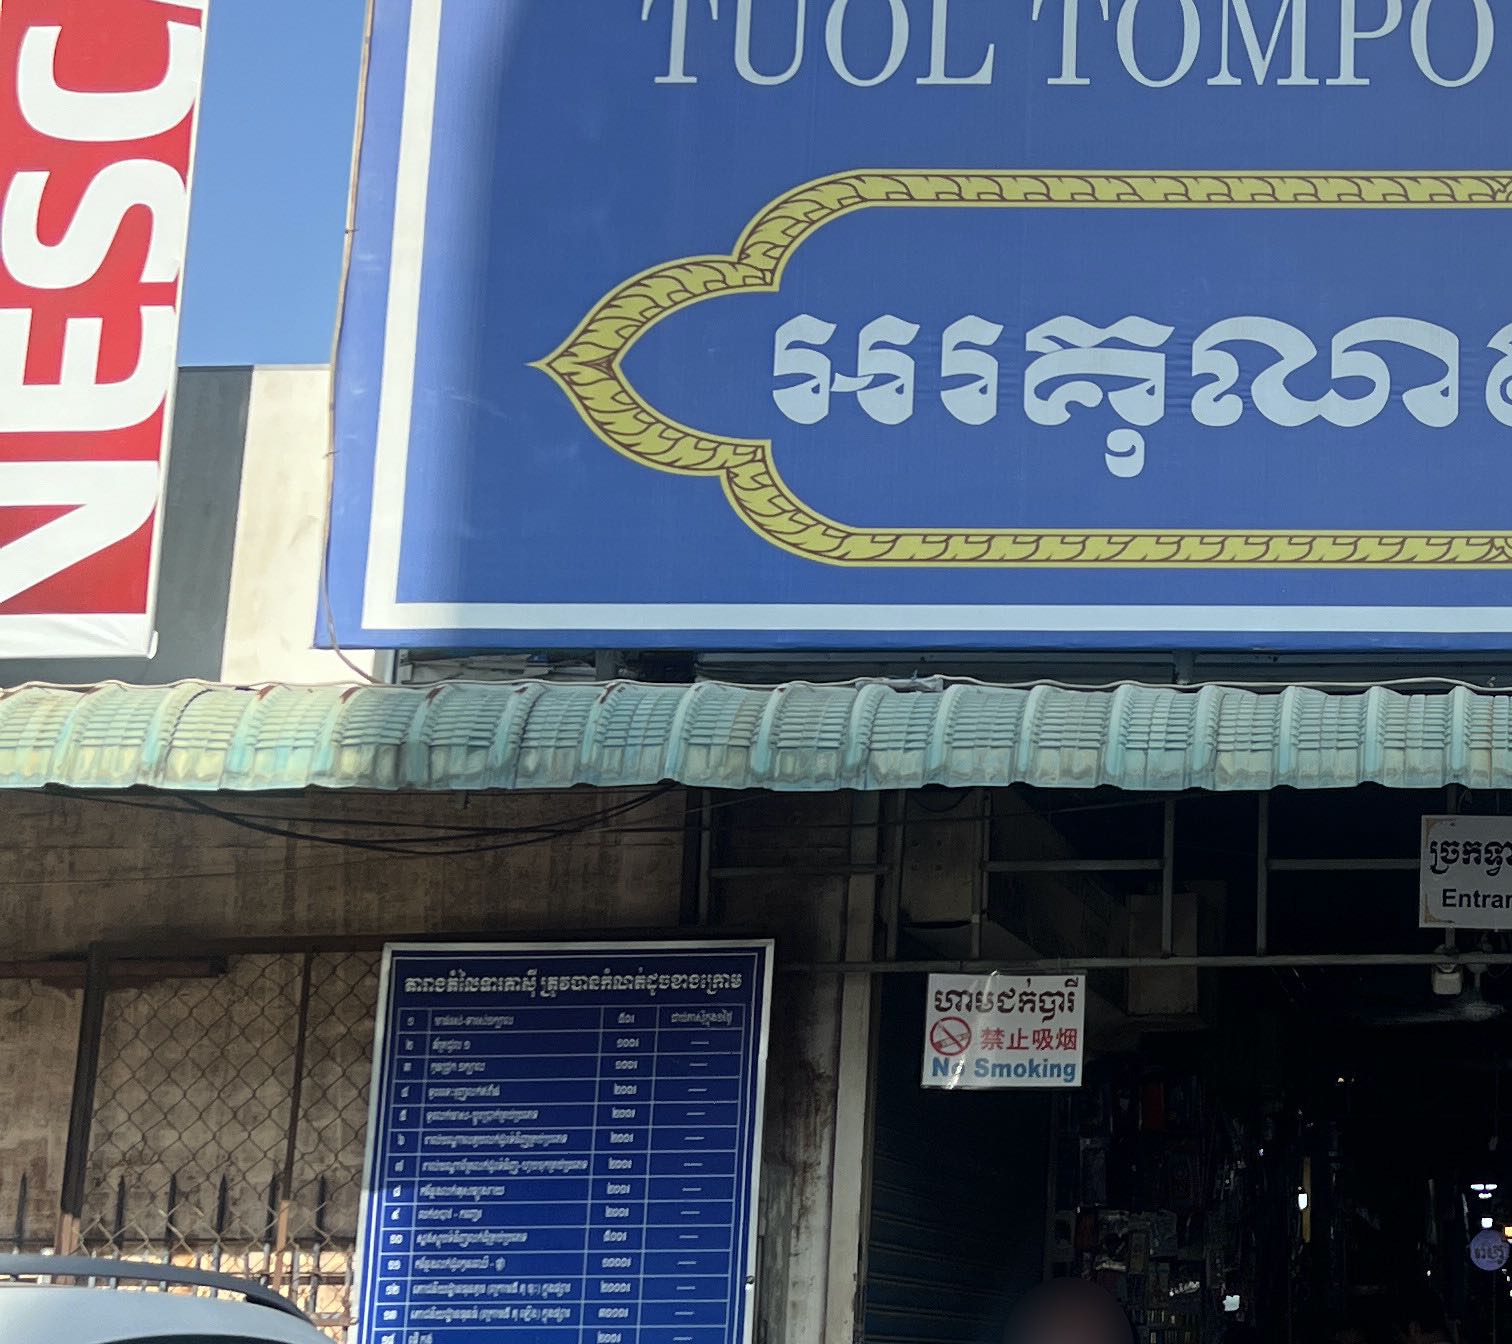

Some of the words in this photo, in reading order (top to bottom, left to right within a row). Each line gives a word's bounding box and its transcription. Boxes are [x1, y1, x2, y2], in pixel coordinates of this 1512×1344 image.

[981, 1027, 1078, 1051] 禁止吸烟
[932, 1057, 966, 1078] No
[974, 1058, 1077, 1084] Smoking
